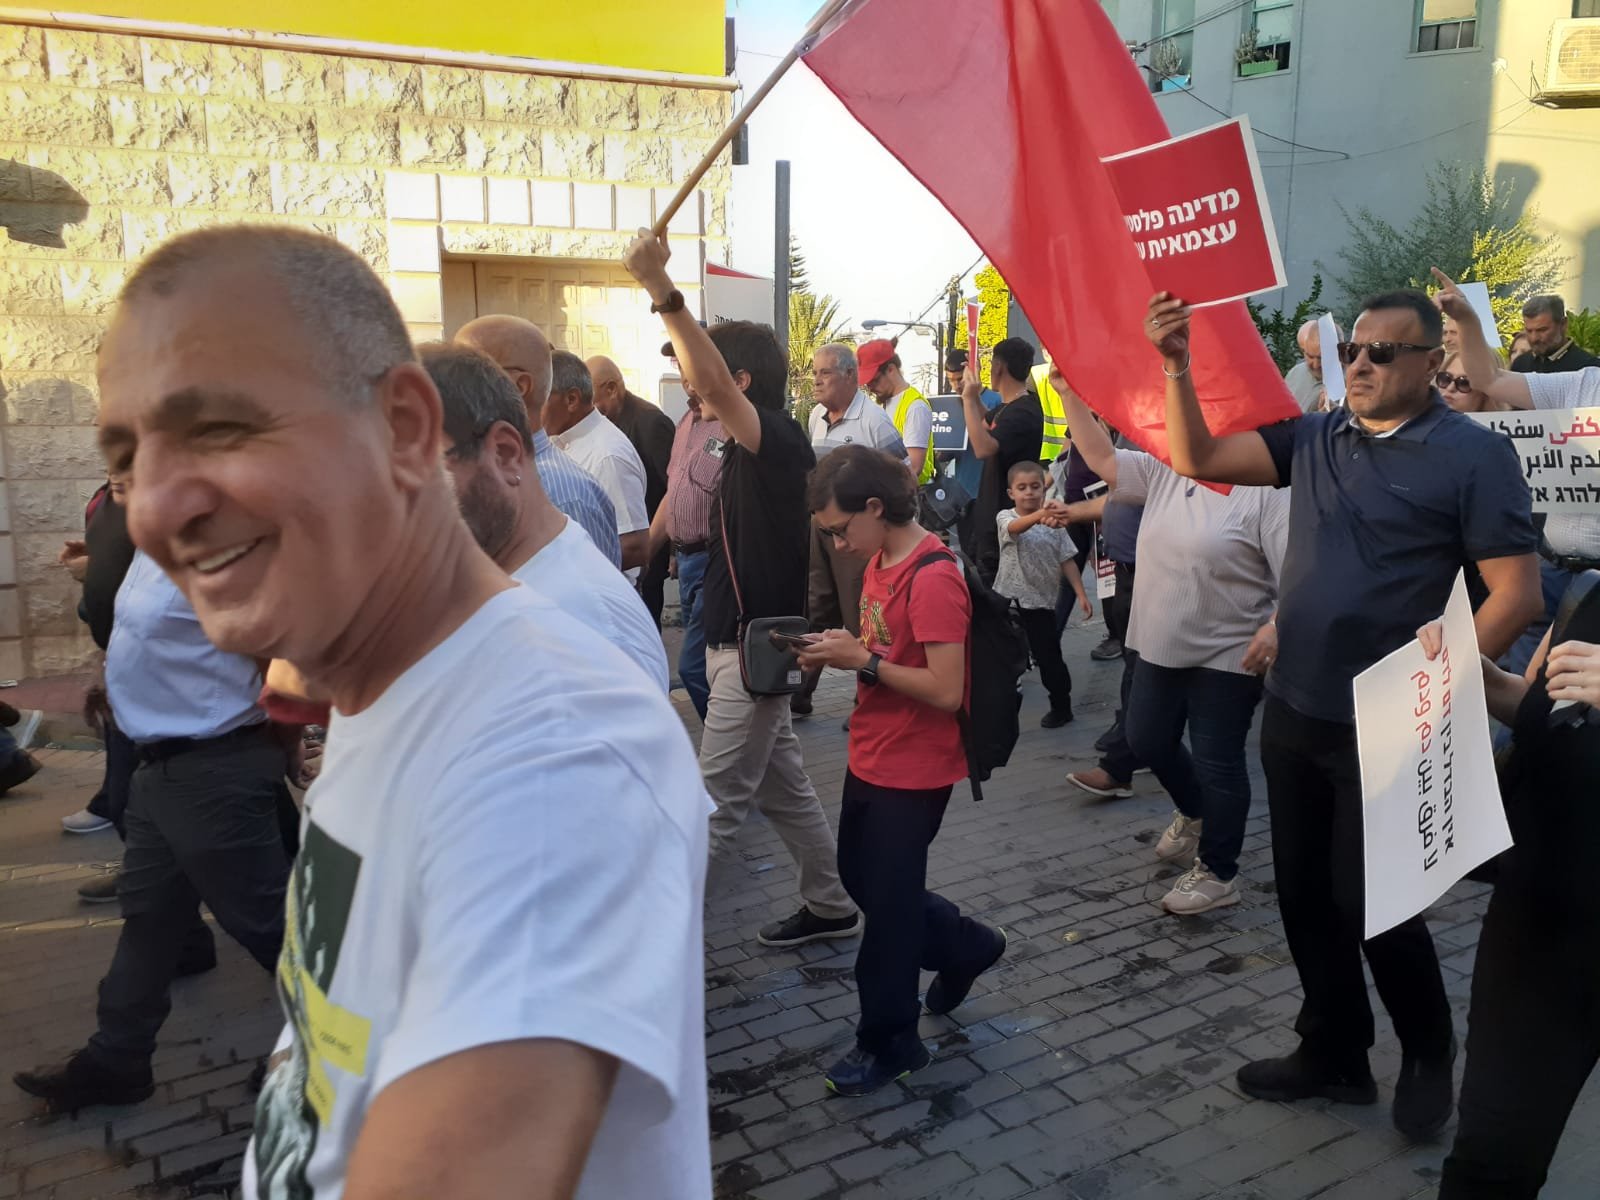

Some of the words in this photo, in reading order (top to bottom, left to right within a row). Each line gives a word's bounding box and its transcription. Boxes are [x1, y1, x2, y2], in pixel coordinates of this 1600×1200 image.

[1167, 187, 1240, 225] מדינה
[1148, 219, 1237, 260] עצמאית
[1555, 483, 1600, 503] להרג
[1410, 670, 1432, 717] ودم
[1442, 688, 1451, 719] דם
[1416, 721, 1432, 754] دم
[1440, 719, 1452, 755] בין
[1417, 758, 1433, 796] بين
[1418, 800, 1438, 850] فرق
[1442, 814, 1454, 855] אין
[1424, 848, 1438, 872] لا
